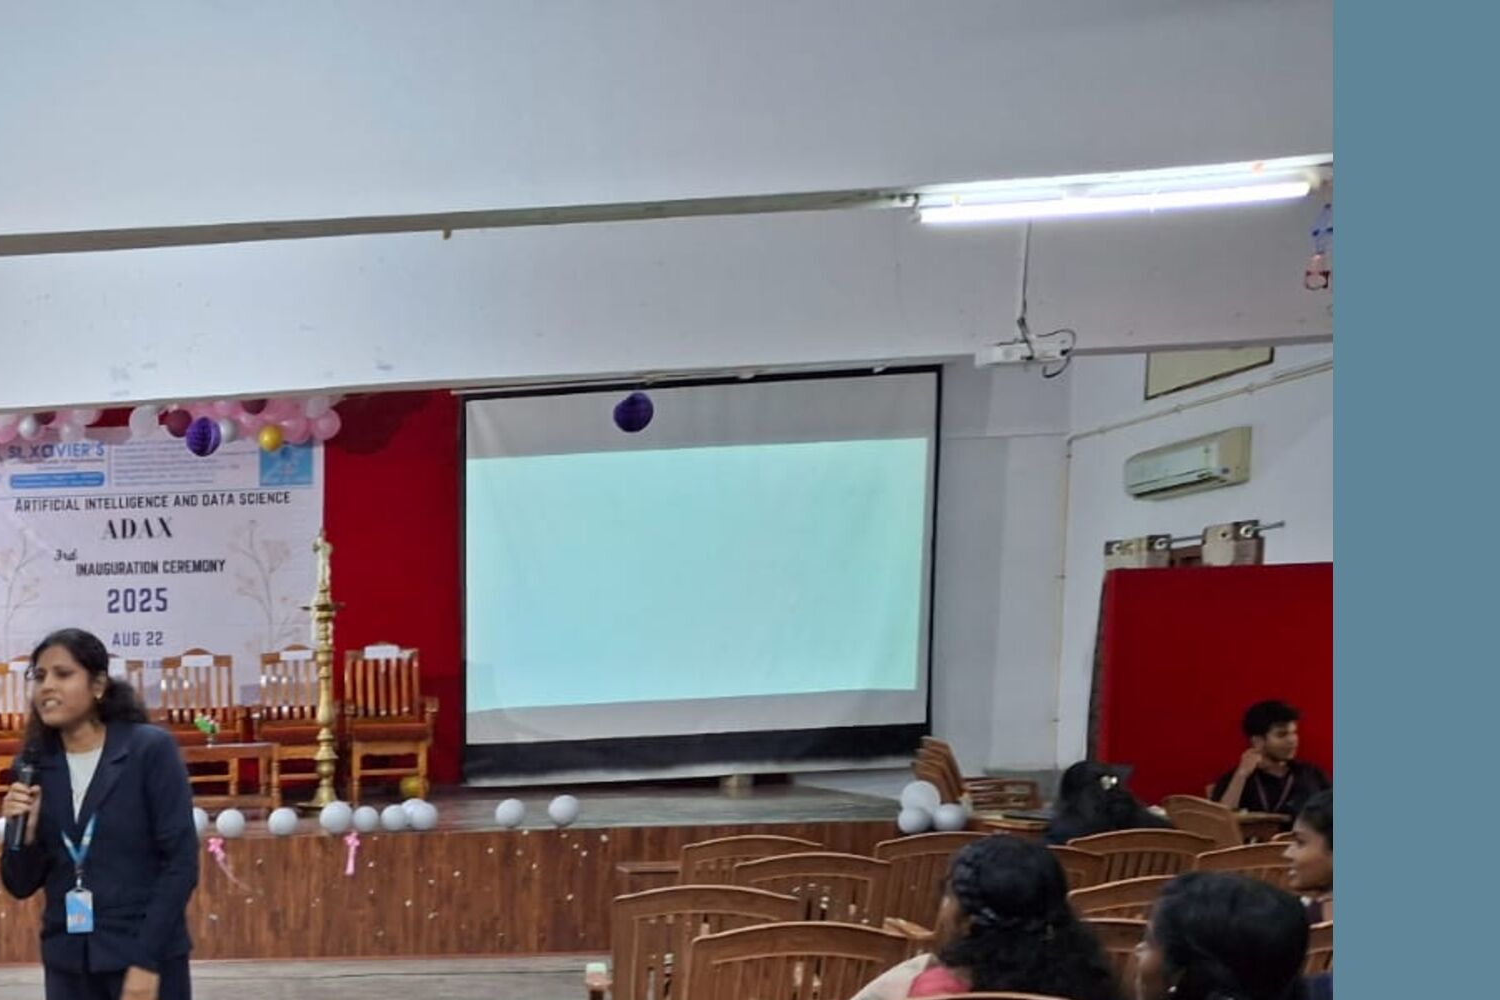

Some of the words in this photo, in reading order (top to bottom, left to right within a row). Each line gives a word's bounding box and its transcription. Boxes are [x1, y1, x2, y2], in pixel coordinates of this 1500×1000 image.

[15, 497, 80, 512] ARTIFICIAL
[85, 495, 168, 509] INTELLIGENCE
[174, 493, 198, 507] AND
[202, 492, 235, 507] DATA
[239, 491, 291, 506] SCIENCE
[101, 517, 173, 540] ADAX
[54, 548, 77, 561] 3rd
[76, 562, 158, 576] INAUGURATION
[162, 560, 226, 574] CEREMONY
[107, 587, 169, 613] 2025
[112, 632, 140, 647] AUG
[146, 631, 164, 646] 22
